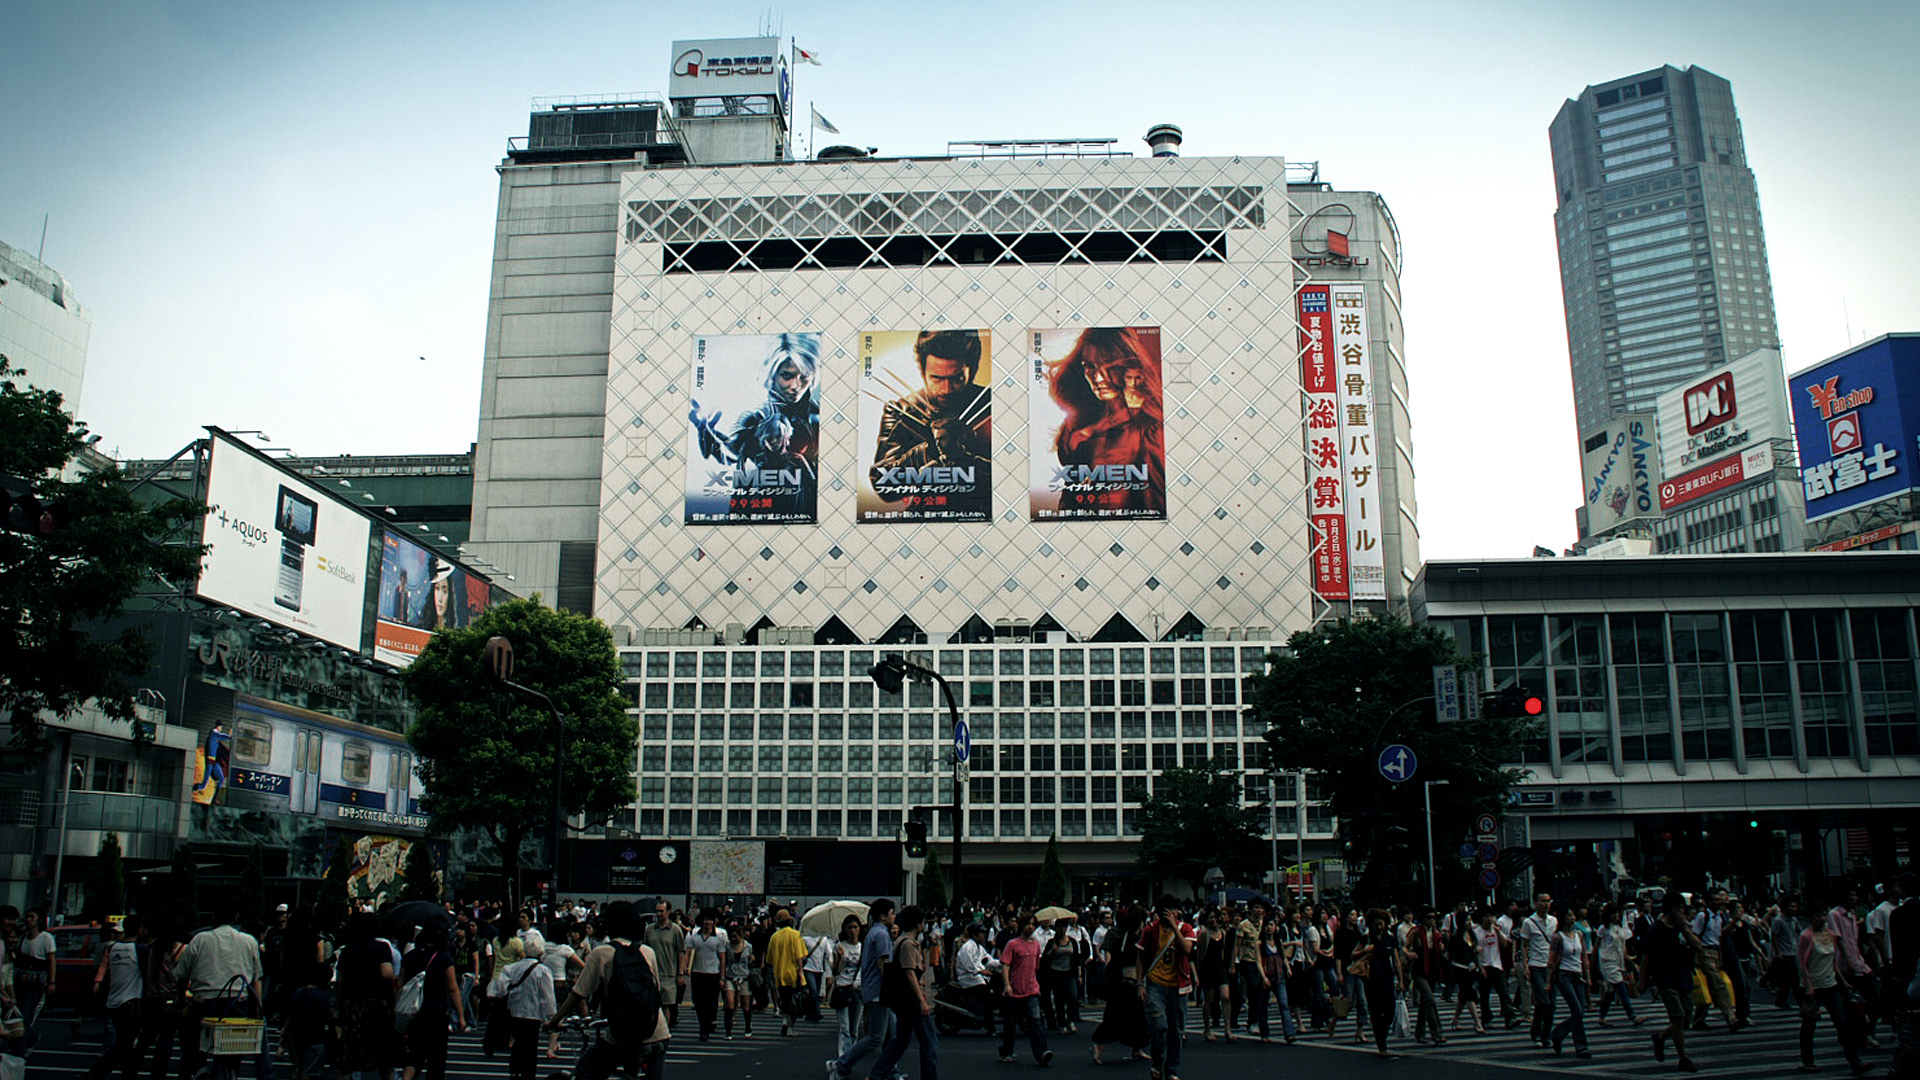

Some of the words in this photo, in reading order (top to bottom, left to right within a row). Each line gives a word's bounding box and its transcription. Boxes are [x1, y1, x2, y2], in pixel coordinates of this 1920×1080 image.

[701, 66, 774, 76] TOKYU
[1293, 256, 1369, 266] TOKYU
[1688, 378, 1733, 428] DC
[1340, 313, 1376, 552] 渋谷骨董バザール
[1687, 435, 1703, 451] DC
[1703, 426, 1726, 444] VISA
[1731, 421, 1739, 432] &
[1308, 398, 1341, 508] 総決算
[1680, 452, 1697, 467] DC
[1697, 429, 1749, 460] MasterCard
[704, 468, 802, 487] X-MEN
[875, 465, 976, 485] X-MEN
[1049, 463, 1149, 483] X-MEN
[1588, 432, 1625, 504] SANKYO
[1629, 421, 1653, 512] SANKYO
[1678, 462, 1740, 496] 三菱東京UFJ銀行
[1804, 442, 1898, 502] 武富士
[703, 487, 747, 497] ファイナル
[748, 486, 802, 497] ディシジョン
[875, 484, 920, 495] ファイナル
[921, 484, 977, 494] ディシジョン
[1048, 482, 1093, 492] ファイナル
[1095, 482, 1149, 491] ディシジョン
[750, 497, 773, 509] 公開
[923, 495, 948, 506] 公開
[232, 518, 268, 544] AQUOS
[327, 560, 357, 586] SoftBank
[198, 634, 230, 670] JR
[230, 650, 283, 684] 渋谷駅
[250, 771, 284, 787] スーパーマン
